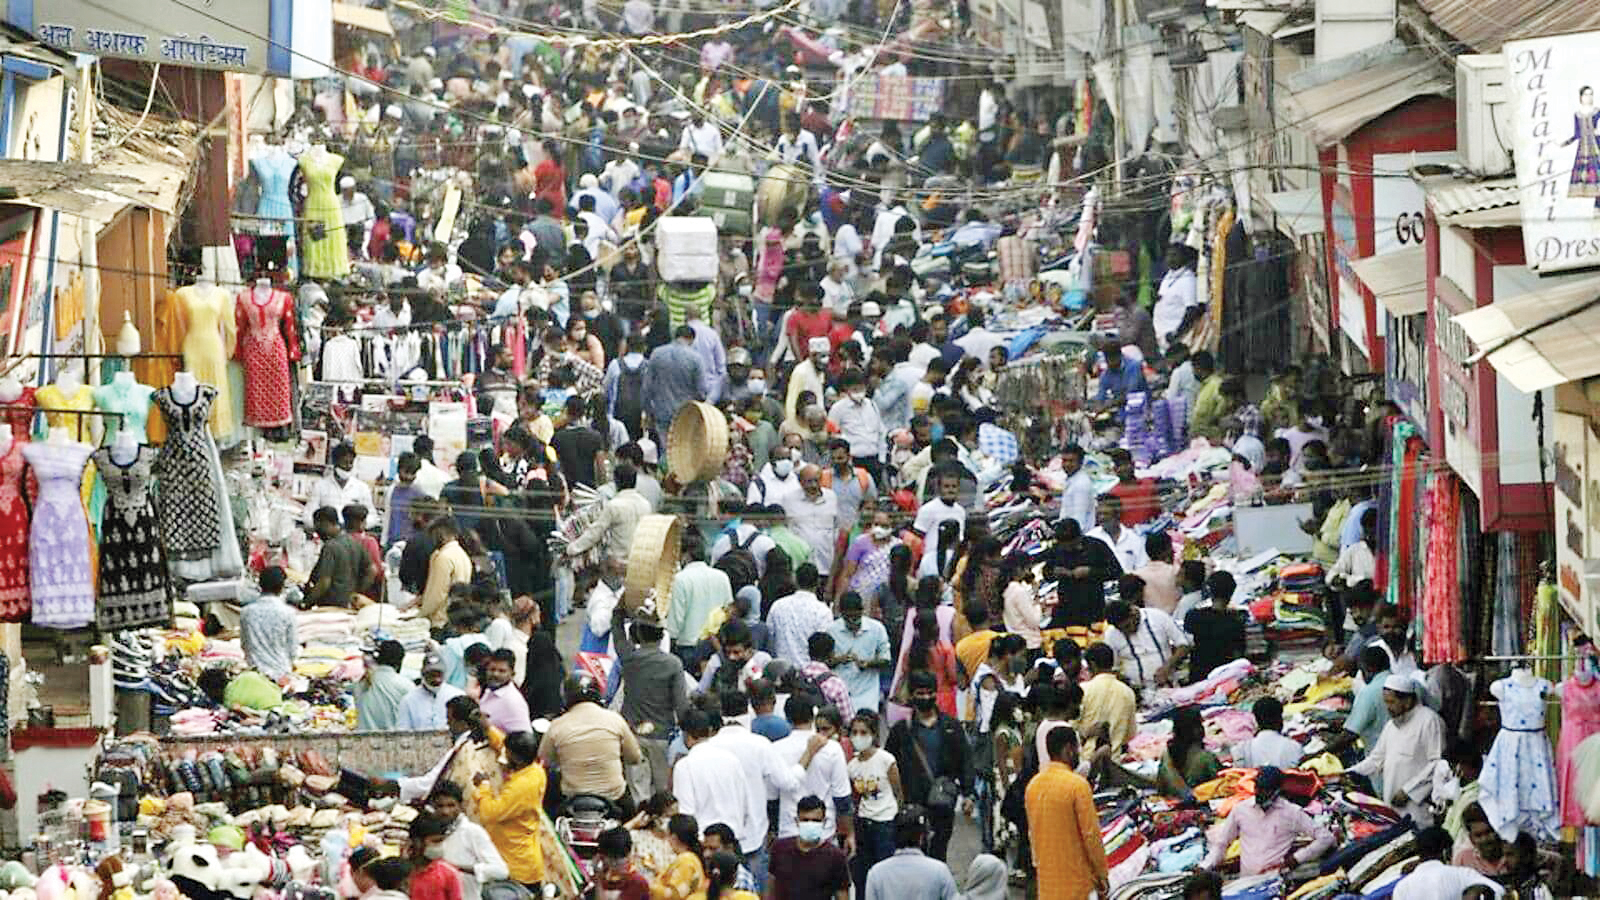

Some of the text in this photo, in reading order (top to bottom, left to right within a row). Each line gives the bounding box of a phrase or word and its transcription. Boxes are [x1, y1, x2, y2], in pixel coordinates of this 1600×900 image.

[40, 25, 72, 46] अल
[87, 31, 146, 54] अशरफ
[1515, 47, 1559, 222] Maharani
